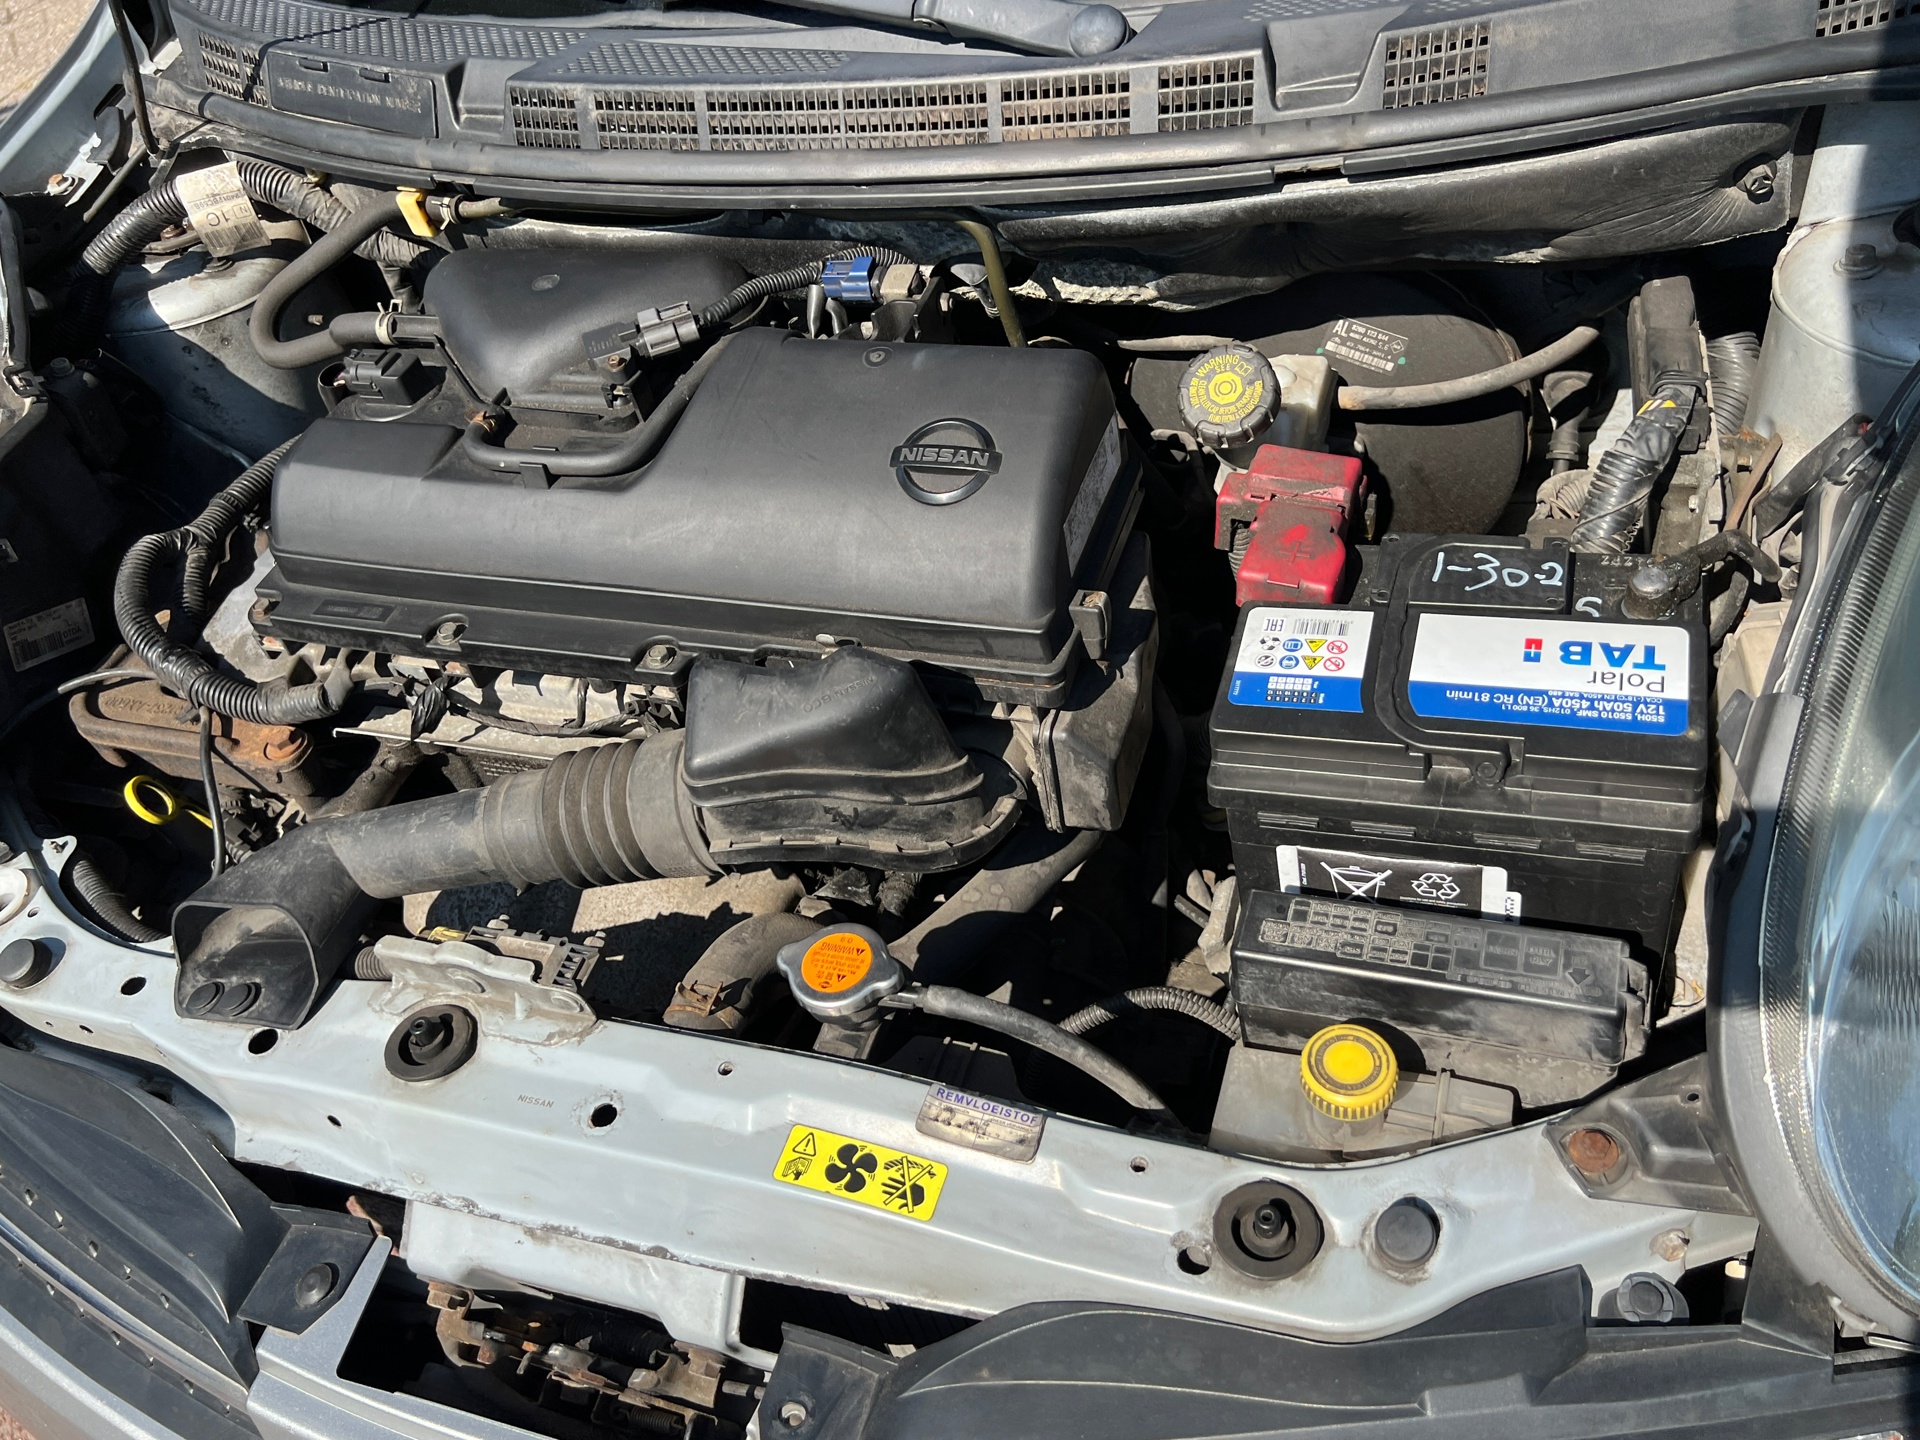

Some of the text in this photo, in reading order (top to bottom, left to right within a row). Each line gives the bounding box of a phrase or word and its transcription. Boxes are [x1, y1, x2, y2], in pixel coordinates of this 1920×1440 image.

[1332, 320, 1349, 337] AL
[1196, 354, 1240, 377] WARNING
[1215, 363, 1230, 373] SEE
[900, 447, 990, 467] NISSAN
[1264, 619, 1284, 631] EAC
[1559, 640, 1666, 671] TAB
[835, 676, 874, 697] NISSAN
[1587, 671, 1665, 693] Polar
[1493, 693, 1514, 703] RC
[1518, 693, 1548, 707] (EN)
[1552, 697, 1590, 709] 450A
[1512, 703, 1528, 711] 800
[1529, 704, 1539, 712] 36
[1574, 707, 1599, 717] SMF,
[1594, 700, 1633, 712] 50Ah
[1636, 703, 1665, 715] 12V
[1601, 710, 1633, 720] 55010
[1635, 712, 1665, 722] S50H,
[821, 942, 855, 955] WARNING
[517, 1094, 554, 1108] NISSAN
[936, 1086, 1039, 1125] REMVLOEISTOF
